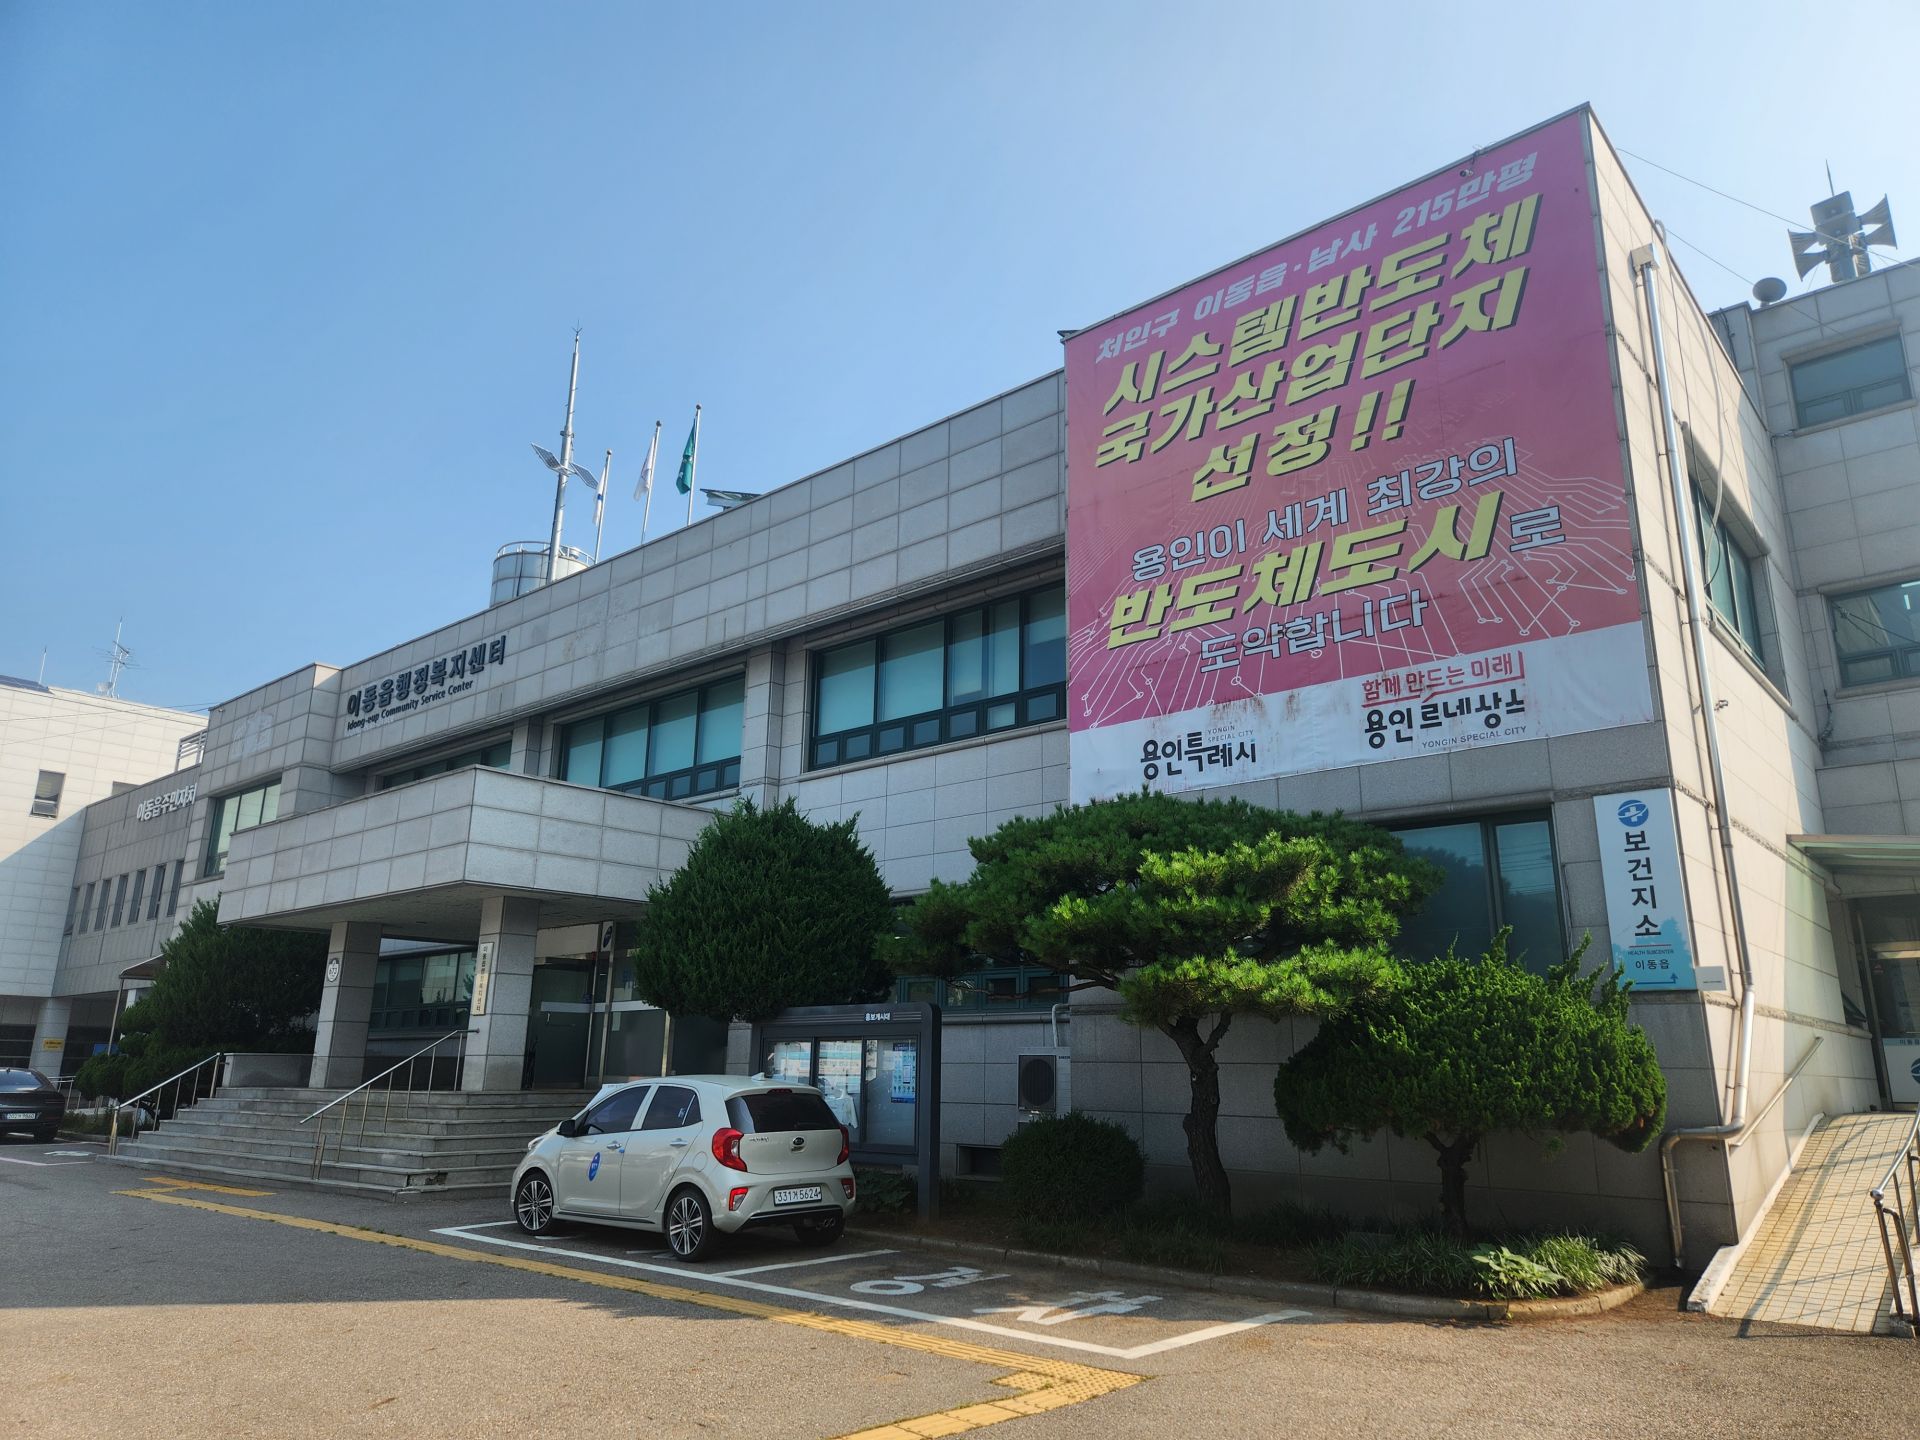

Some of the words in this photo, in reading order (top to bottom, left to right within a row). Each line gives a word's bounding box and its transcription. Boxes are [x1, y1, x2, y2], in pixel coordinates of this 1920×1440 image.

[1096, 308, 1180, 364] 처인구
[1391, 151, 1538, 238] 215만평
[1102, 193, 1543, 416] 시스템반도체
[1095, 265, 1529, 467] 국가산업단지
[1191, 378, 1416, 502] 선정!!
[1132, 519, 1247, 583] 용인이
[1262, 488, 1349, 545] 세계
[1366, 437, 1518, 517] 최강의
[1200, 589, 1428, 674] 도약합니다
[347, 635, 507, 717] 이동읍행정복지센터
[381, 699, 419, 719] Community
[421, 689, 446, 706] Service
[447, 680, 473, 695] Center
[1362, 675, 1400, 701] 함께
[1405, 666, 1465, 693] 만드는
[1471, 652, 1513, 679] 미래
[1140, 731, 1256, 780] 용인특례시
[1207, 725, 1235, 735] YONGIN
[1207, 733, 1235, 742] SPECIAL
[1238, 729, 1254, 738] CITY
[1422, 738, 1457, 749] YONGIN
[1460, 730, 1501, 743] SPECIAL
[1505, 725, 1527, 736] CITY
[1624, 830, 1661, 937] 보건지소
[1635, 959, 1669, 971] 이동읍
[865, 1012, 890, 1022] 홍보게시대
